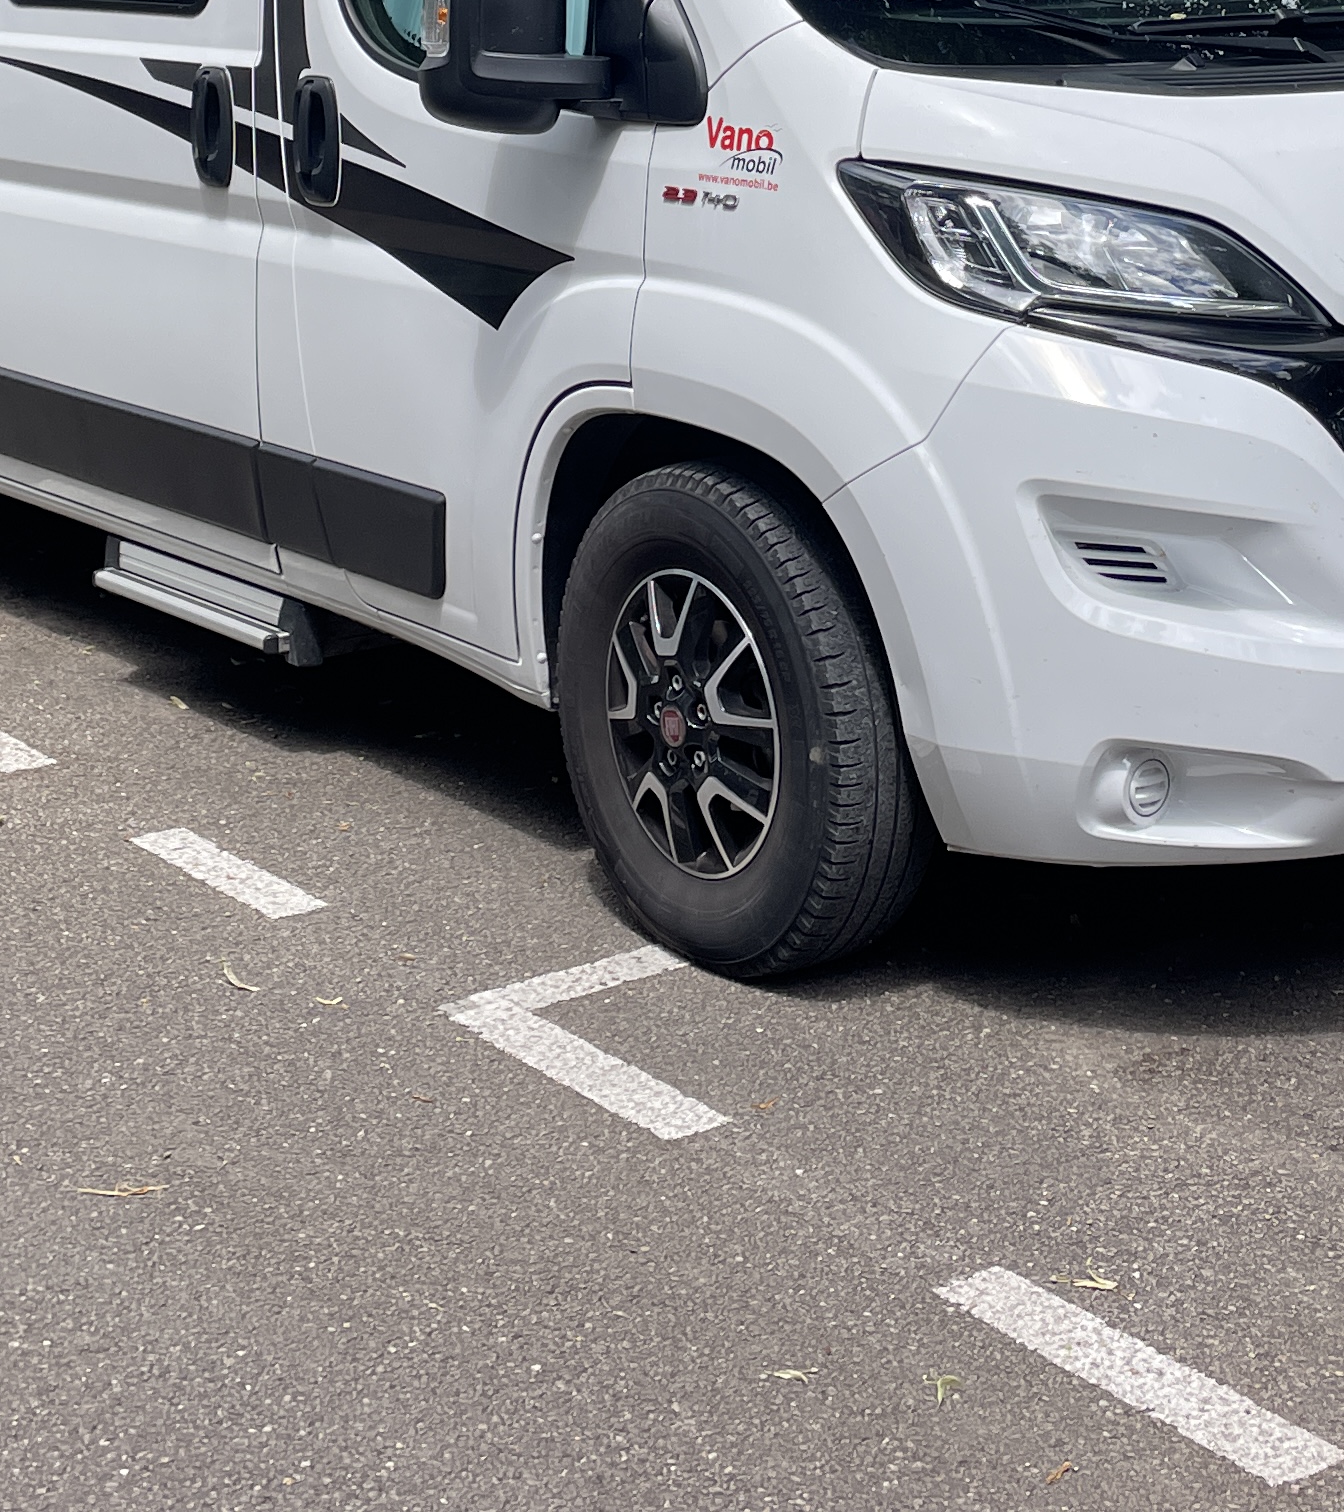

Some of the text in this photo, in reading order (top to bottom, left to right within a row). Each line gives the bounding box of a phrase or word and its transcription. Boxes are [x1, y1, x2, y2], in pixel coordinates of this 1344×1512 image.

[706, 115, 774, 152] Vano
[730, 155, 778, 176] mobil
[697, 172, 779, 192] www.vanomobil.be
